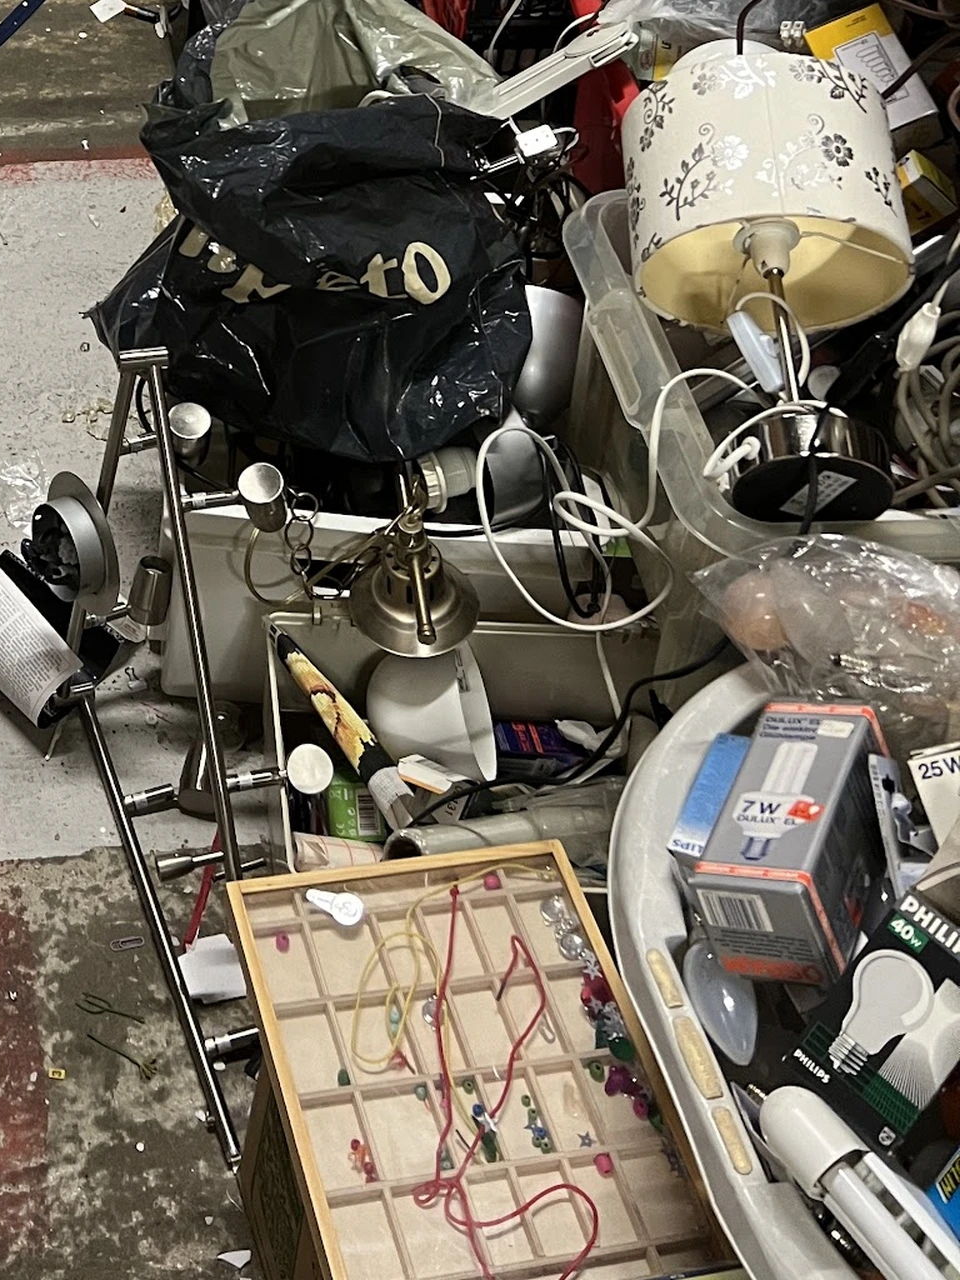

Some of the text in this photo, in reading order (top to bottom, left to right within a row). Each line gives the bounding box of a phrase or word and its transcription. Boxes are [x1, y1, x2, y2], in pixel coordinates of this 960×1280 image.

[918, 762, 944, 780] 25
[742, 800, 782, 815] 7 W
[737, 814, 776, 825] DULUX
[899, 894, 960, 960] PHILI
[793, 1048, 831, 1084] PHILIPS
